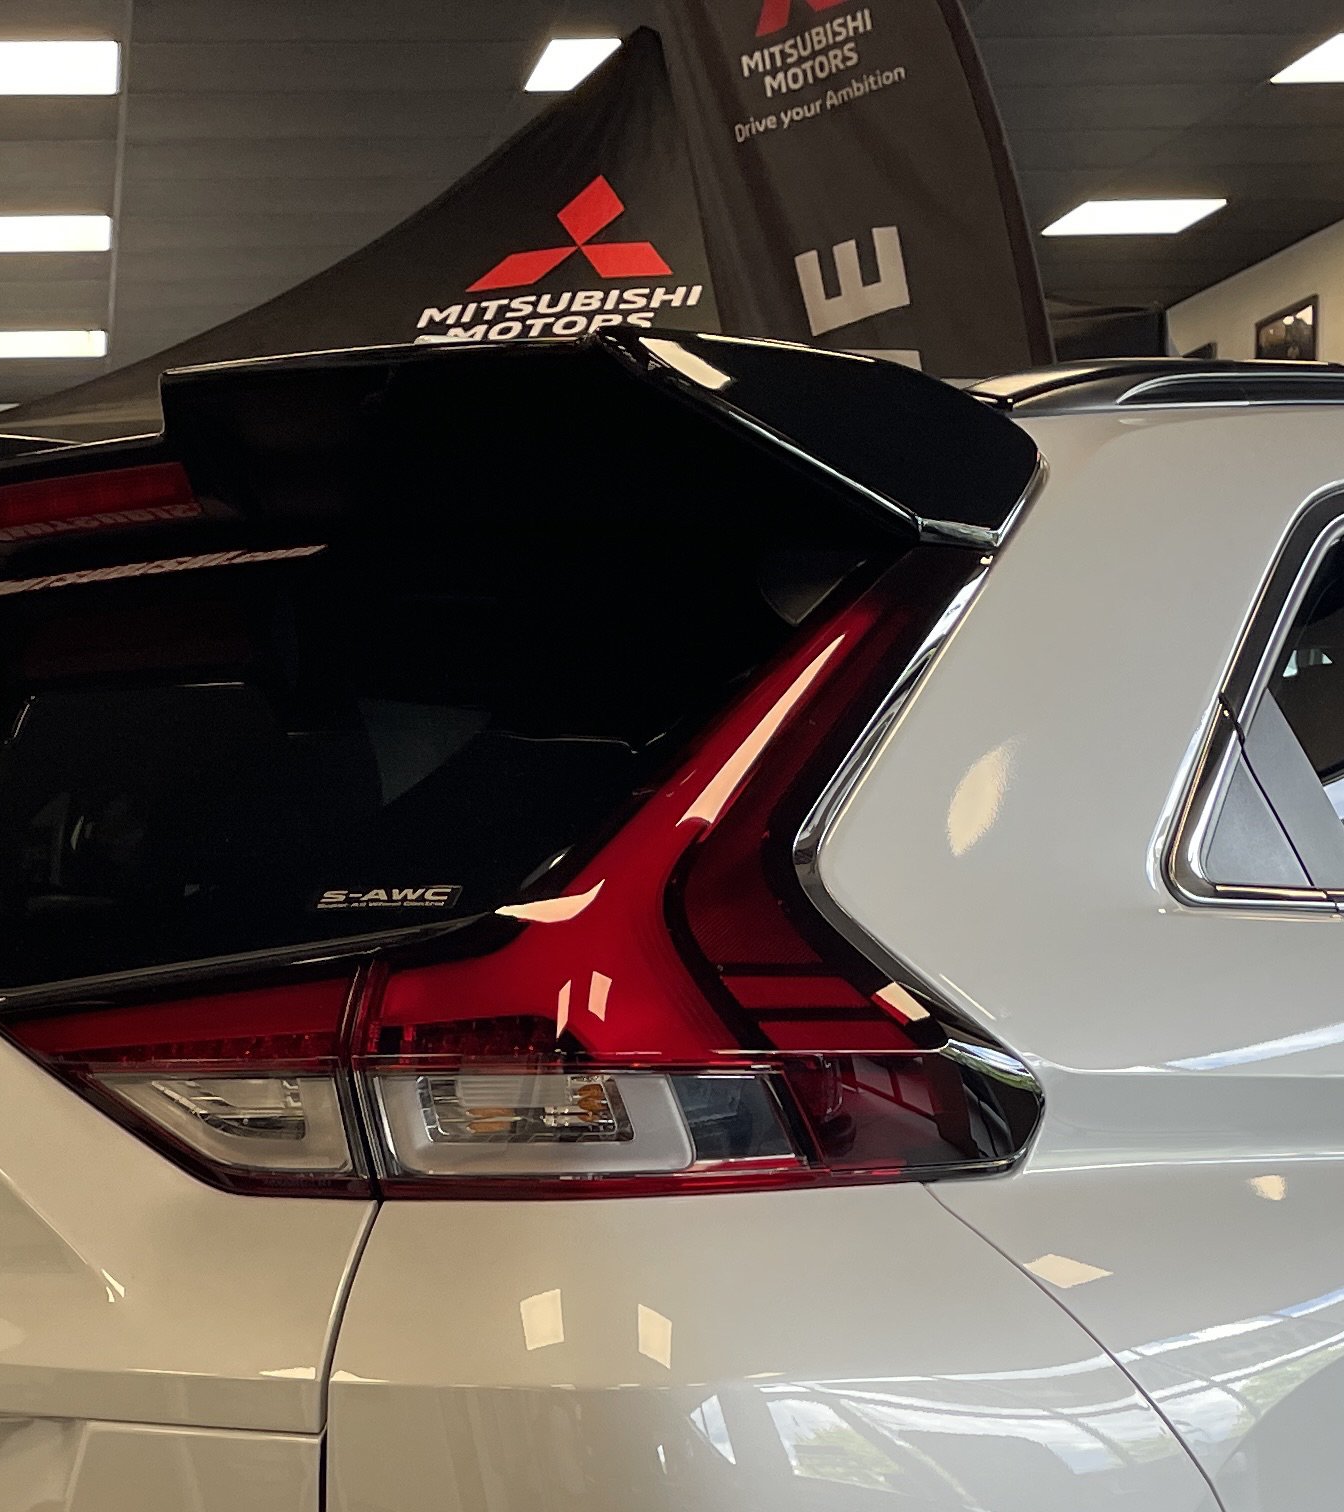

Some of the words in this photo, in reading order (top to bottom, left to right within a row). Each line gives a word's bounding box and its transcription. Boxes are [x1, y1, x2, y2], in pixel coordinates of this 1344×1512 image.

[740, 8, 873, 78] MITSUBISHI
[763, 42, 859, 98] MOTORS
[734, 115, 778, 143] Drive
[780, 99, 823, 129] your
[825, 66, 906, 110] Ambition
[416, 285, 703, 329] MITSUBISHI
[319, 888, 452, 903] S-AWC
